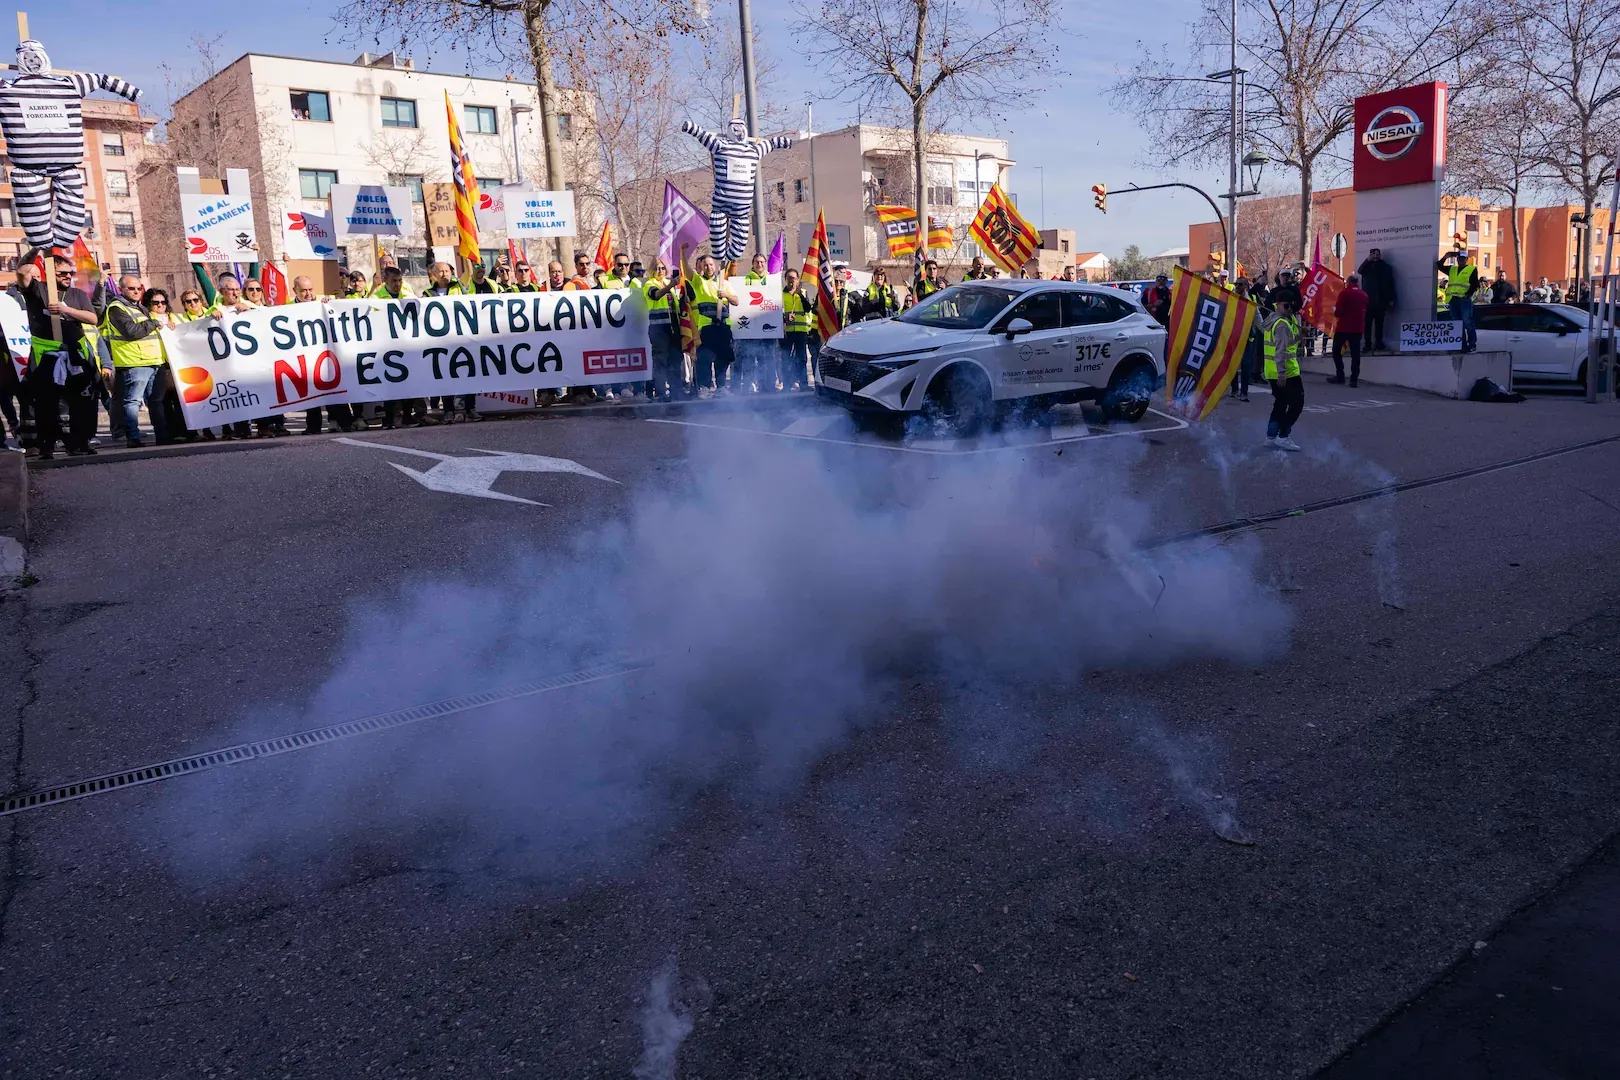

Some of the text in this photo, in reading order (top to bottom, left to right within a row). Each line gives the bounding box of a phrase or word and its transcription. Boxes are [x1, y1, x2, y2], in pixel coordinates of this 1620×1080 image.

[1367, 125, 1416, 141] NISSAN
[356, 195, 388, 203] VOLEM
[436, 192, 449, 201] DS
[198, 199, 230, 217] NO AL
[525, 200, 553, 208] VOLEM
[356, 206, 391, 214] SEGUIR
[491, 205, 504, 213] Smi
[188, 203, 251, 233] TANCAMENT
[345, 217, 403, 226] TREBALLANT
[307, 223, 319, 232] DS
[516, 221, 566, 229] TREBALLANT
[1377, 225, 1410, 234] Intelligent
[1410, 223, 1432, 231] Choice
[303, 229, 328, 238] Smith
[208, 247, 221, 255] DS
[204, 253, 230, 261] Smith
[1302, 270, 1328, 308] UGT
[208, 294, 626, 361] DS Smith MONTBLANC
[1402, 323, 1454, 332] DEJADNOS
[1186, 299, 1220, 370] CCOO
[1414, 330, 1450, 338] SEGUIR
[1402, 337, 1463, 346] TRABAJANDO
[1075, 342, 1111, 362] 317€
[588, 352, 643, 370] CCOO
[274, 341, 563, 404] NO ES TANCA
[1074, 363, 1082, 373] al
[215, 379, 239, 397] DS
[209, 390, 260, 413] Smith
